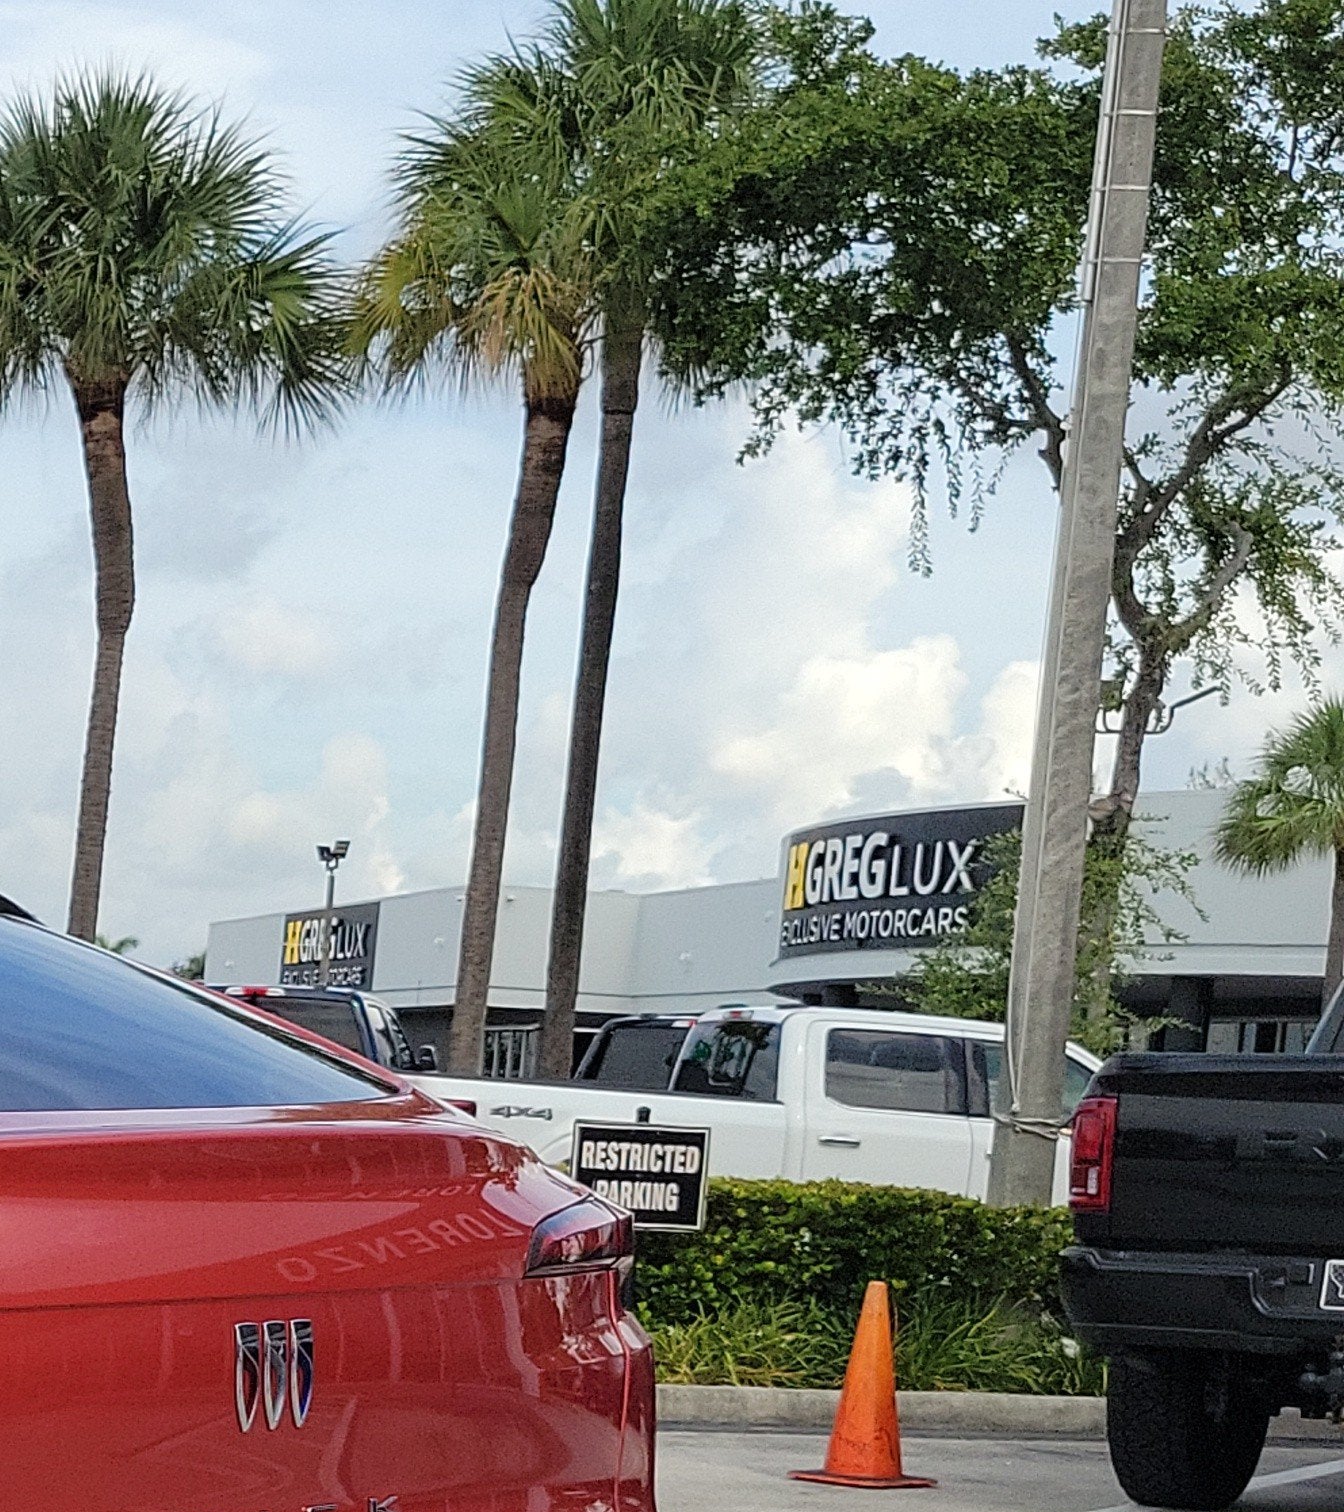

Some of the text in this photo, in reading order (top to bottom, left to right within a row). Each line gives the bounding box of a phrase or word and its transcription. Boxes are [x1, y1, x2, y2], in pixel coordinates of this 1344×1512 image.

[888, 840, 976, 897] LUX
[843, 906, 970, 940] MOTORCARS
[336, 922, 367, 959] LUX
[580, 1140, 701, 1174] RESTRICTED
[595, 1179, 680, 1212] PARKING
